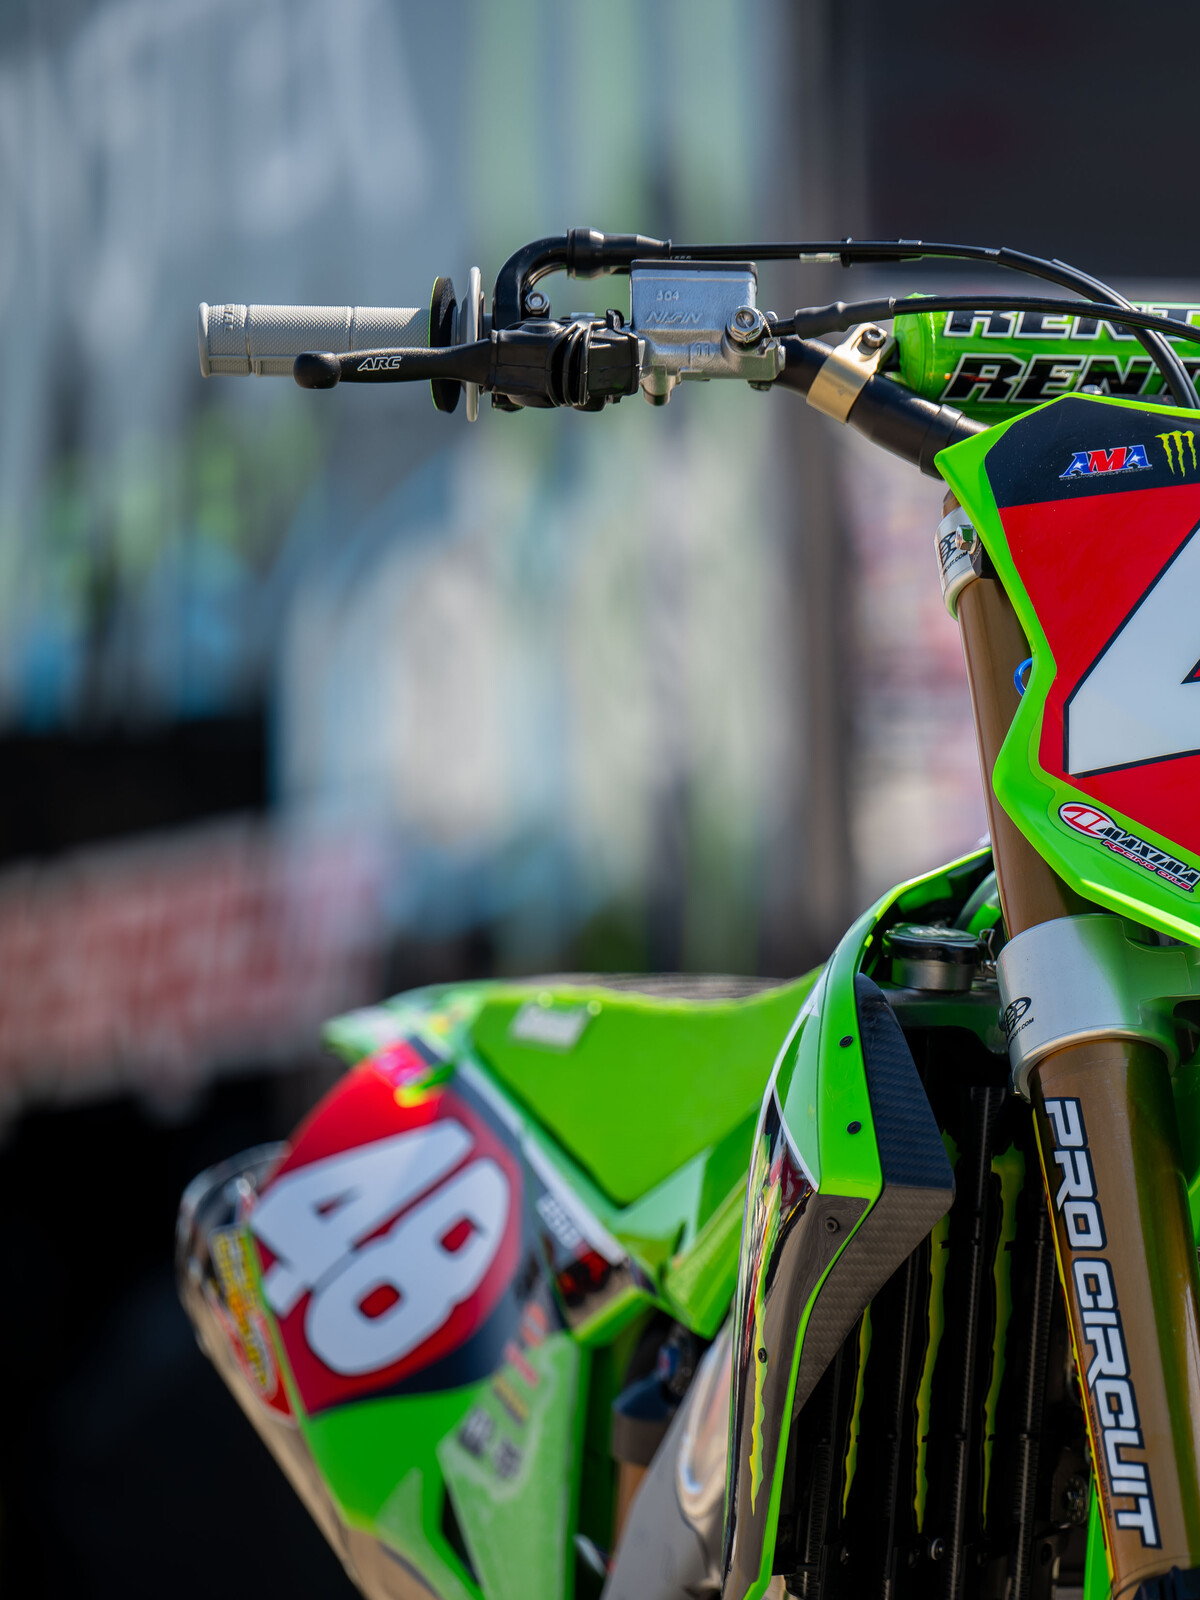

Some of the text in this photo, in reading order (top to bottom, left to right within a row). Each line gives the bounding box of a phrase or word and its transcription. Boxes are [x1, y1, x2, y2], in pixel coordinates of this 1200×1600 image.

[357, 356, 402, 372] ARC
[1059, 445, 1152, 478] AMA
[1103, 840, 1192, 891] RACING OILS
[249, 1117, 512, 1378] 48
[1043, 1098, 1161, 1548] PRO CIRCUIT
